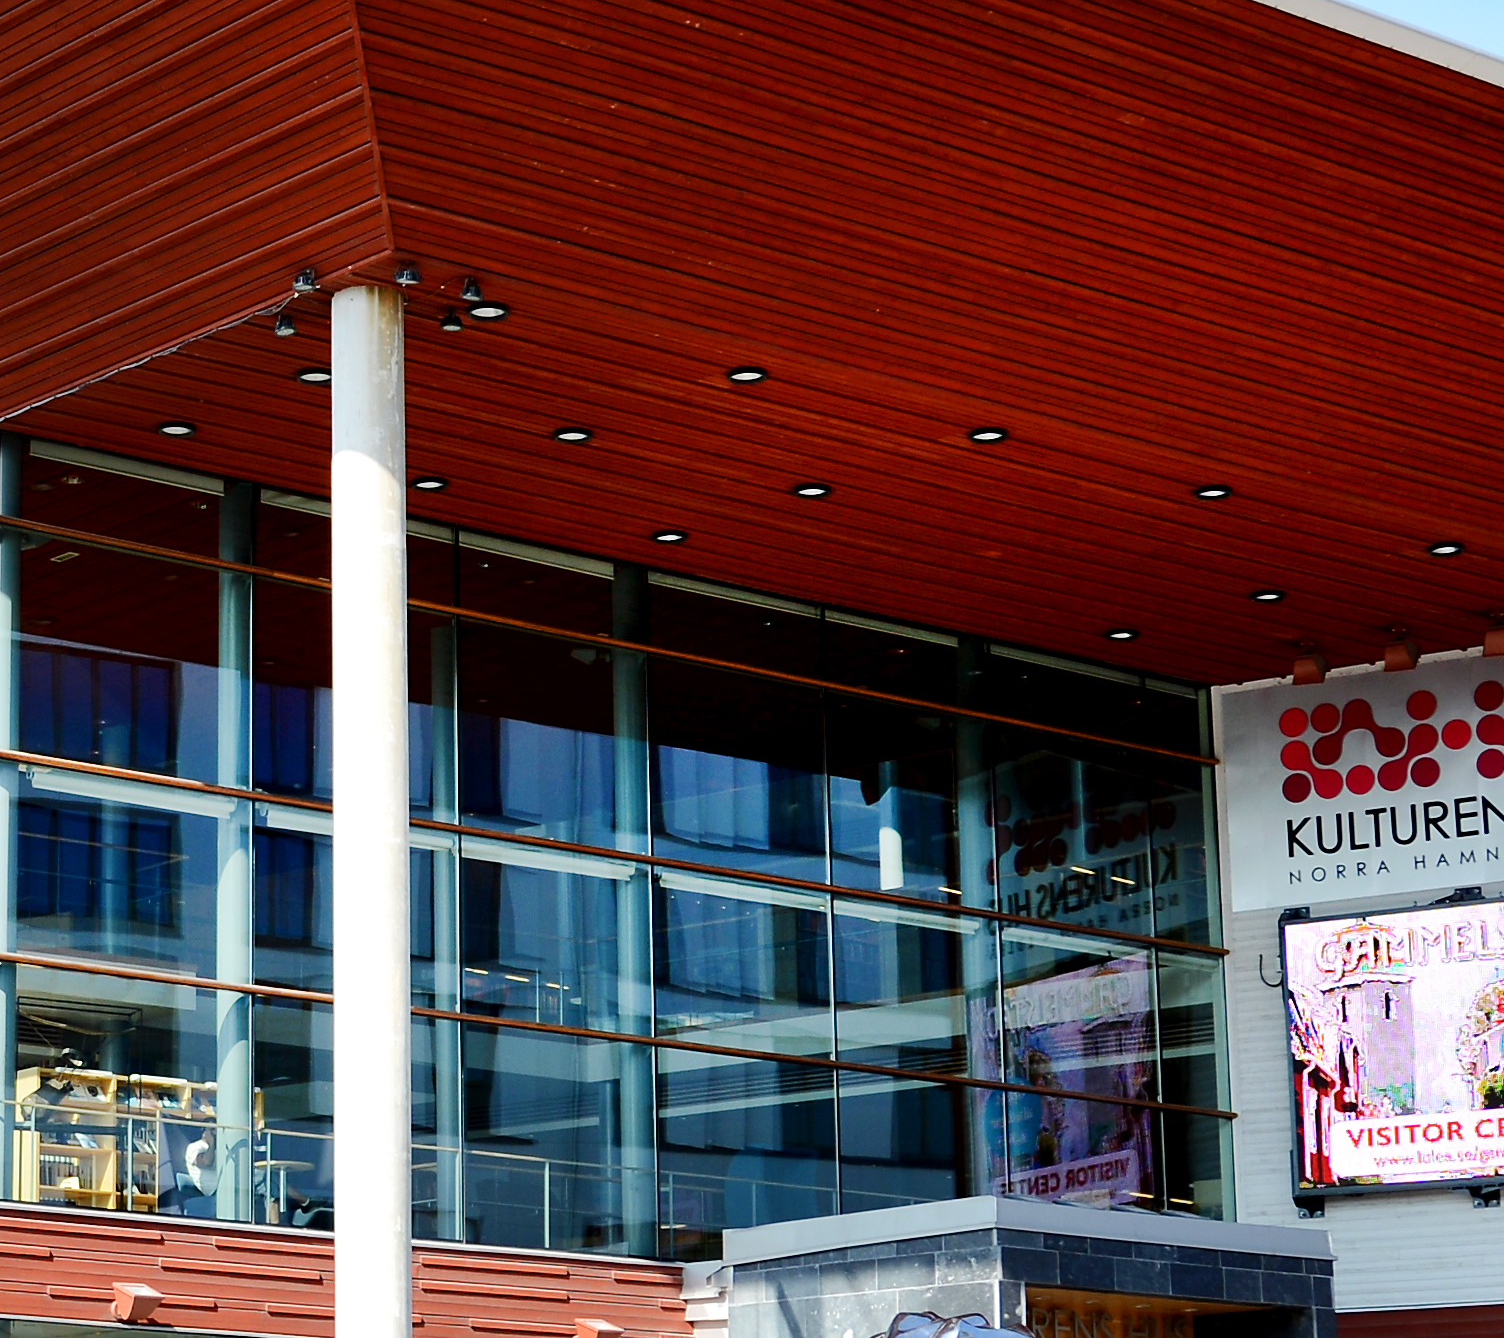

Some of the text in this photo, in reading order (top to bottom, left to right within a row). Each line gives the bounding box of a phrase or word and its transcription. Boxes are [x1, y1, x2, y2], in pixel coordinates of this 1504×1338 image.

[1289, 859, 1390, 885] NORRA
[1413, 846, 1500, 870] HAMN
[1346, 1119, 1464, 1149] VISITOR
